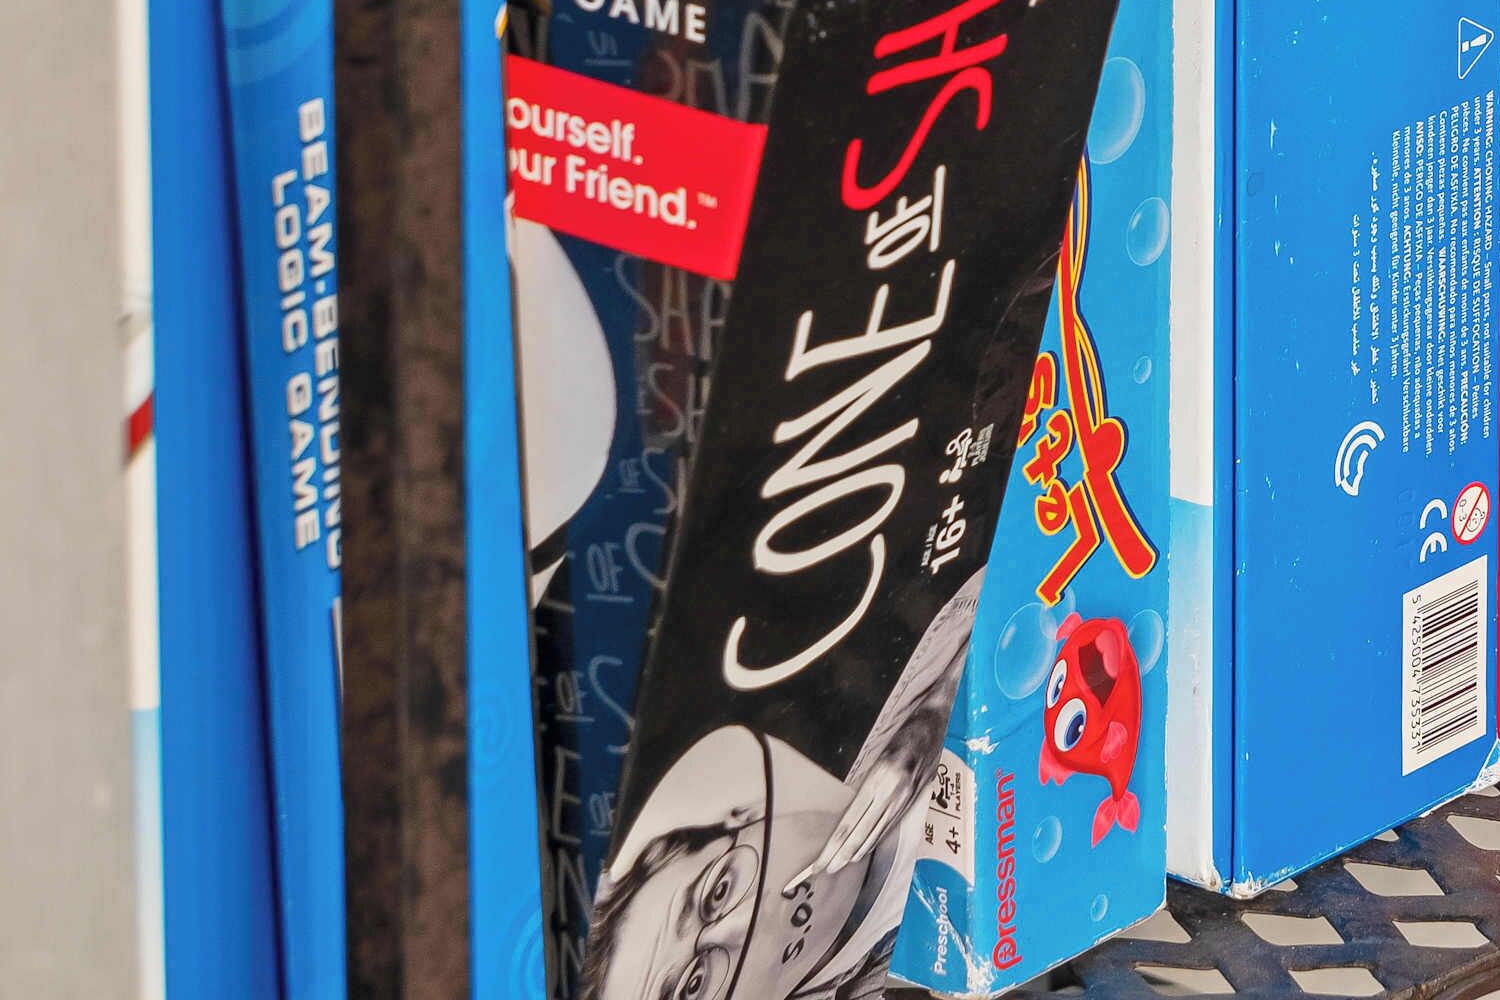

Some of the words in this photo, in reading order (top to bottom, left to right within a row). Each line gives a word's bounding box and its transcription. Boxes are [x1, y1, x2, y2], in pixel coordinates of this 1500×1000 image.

[271, 168, 309, 355] LOGIC
[286, 371, 321, 552] GAME
[723, 259, 956, 691] CONE
[865, 165, 947, 271] OF
[933, 494, 966, 575] 16+
[1411, 593, 1422, 606] 5
[1411, 615, 1422, 679] 425004
[924, 820, 935, 845] AGE
[944, 825, 961, 855] 4+
[992, 767, 1023, 971] pressman
[933, 886, 949, 976] Preschool
